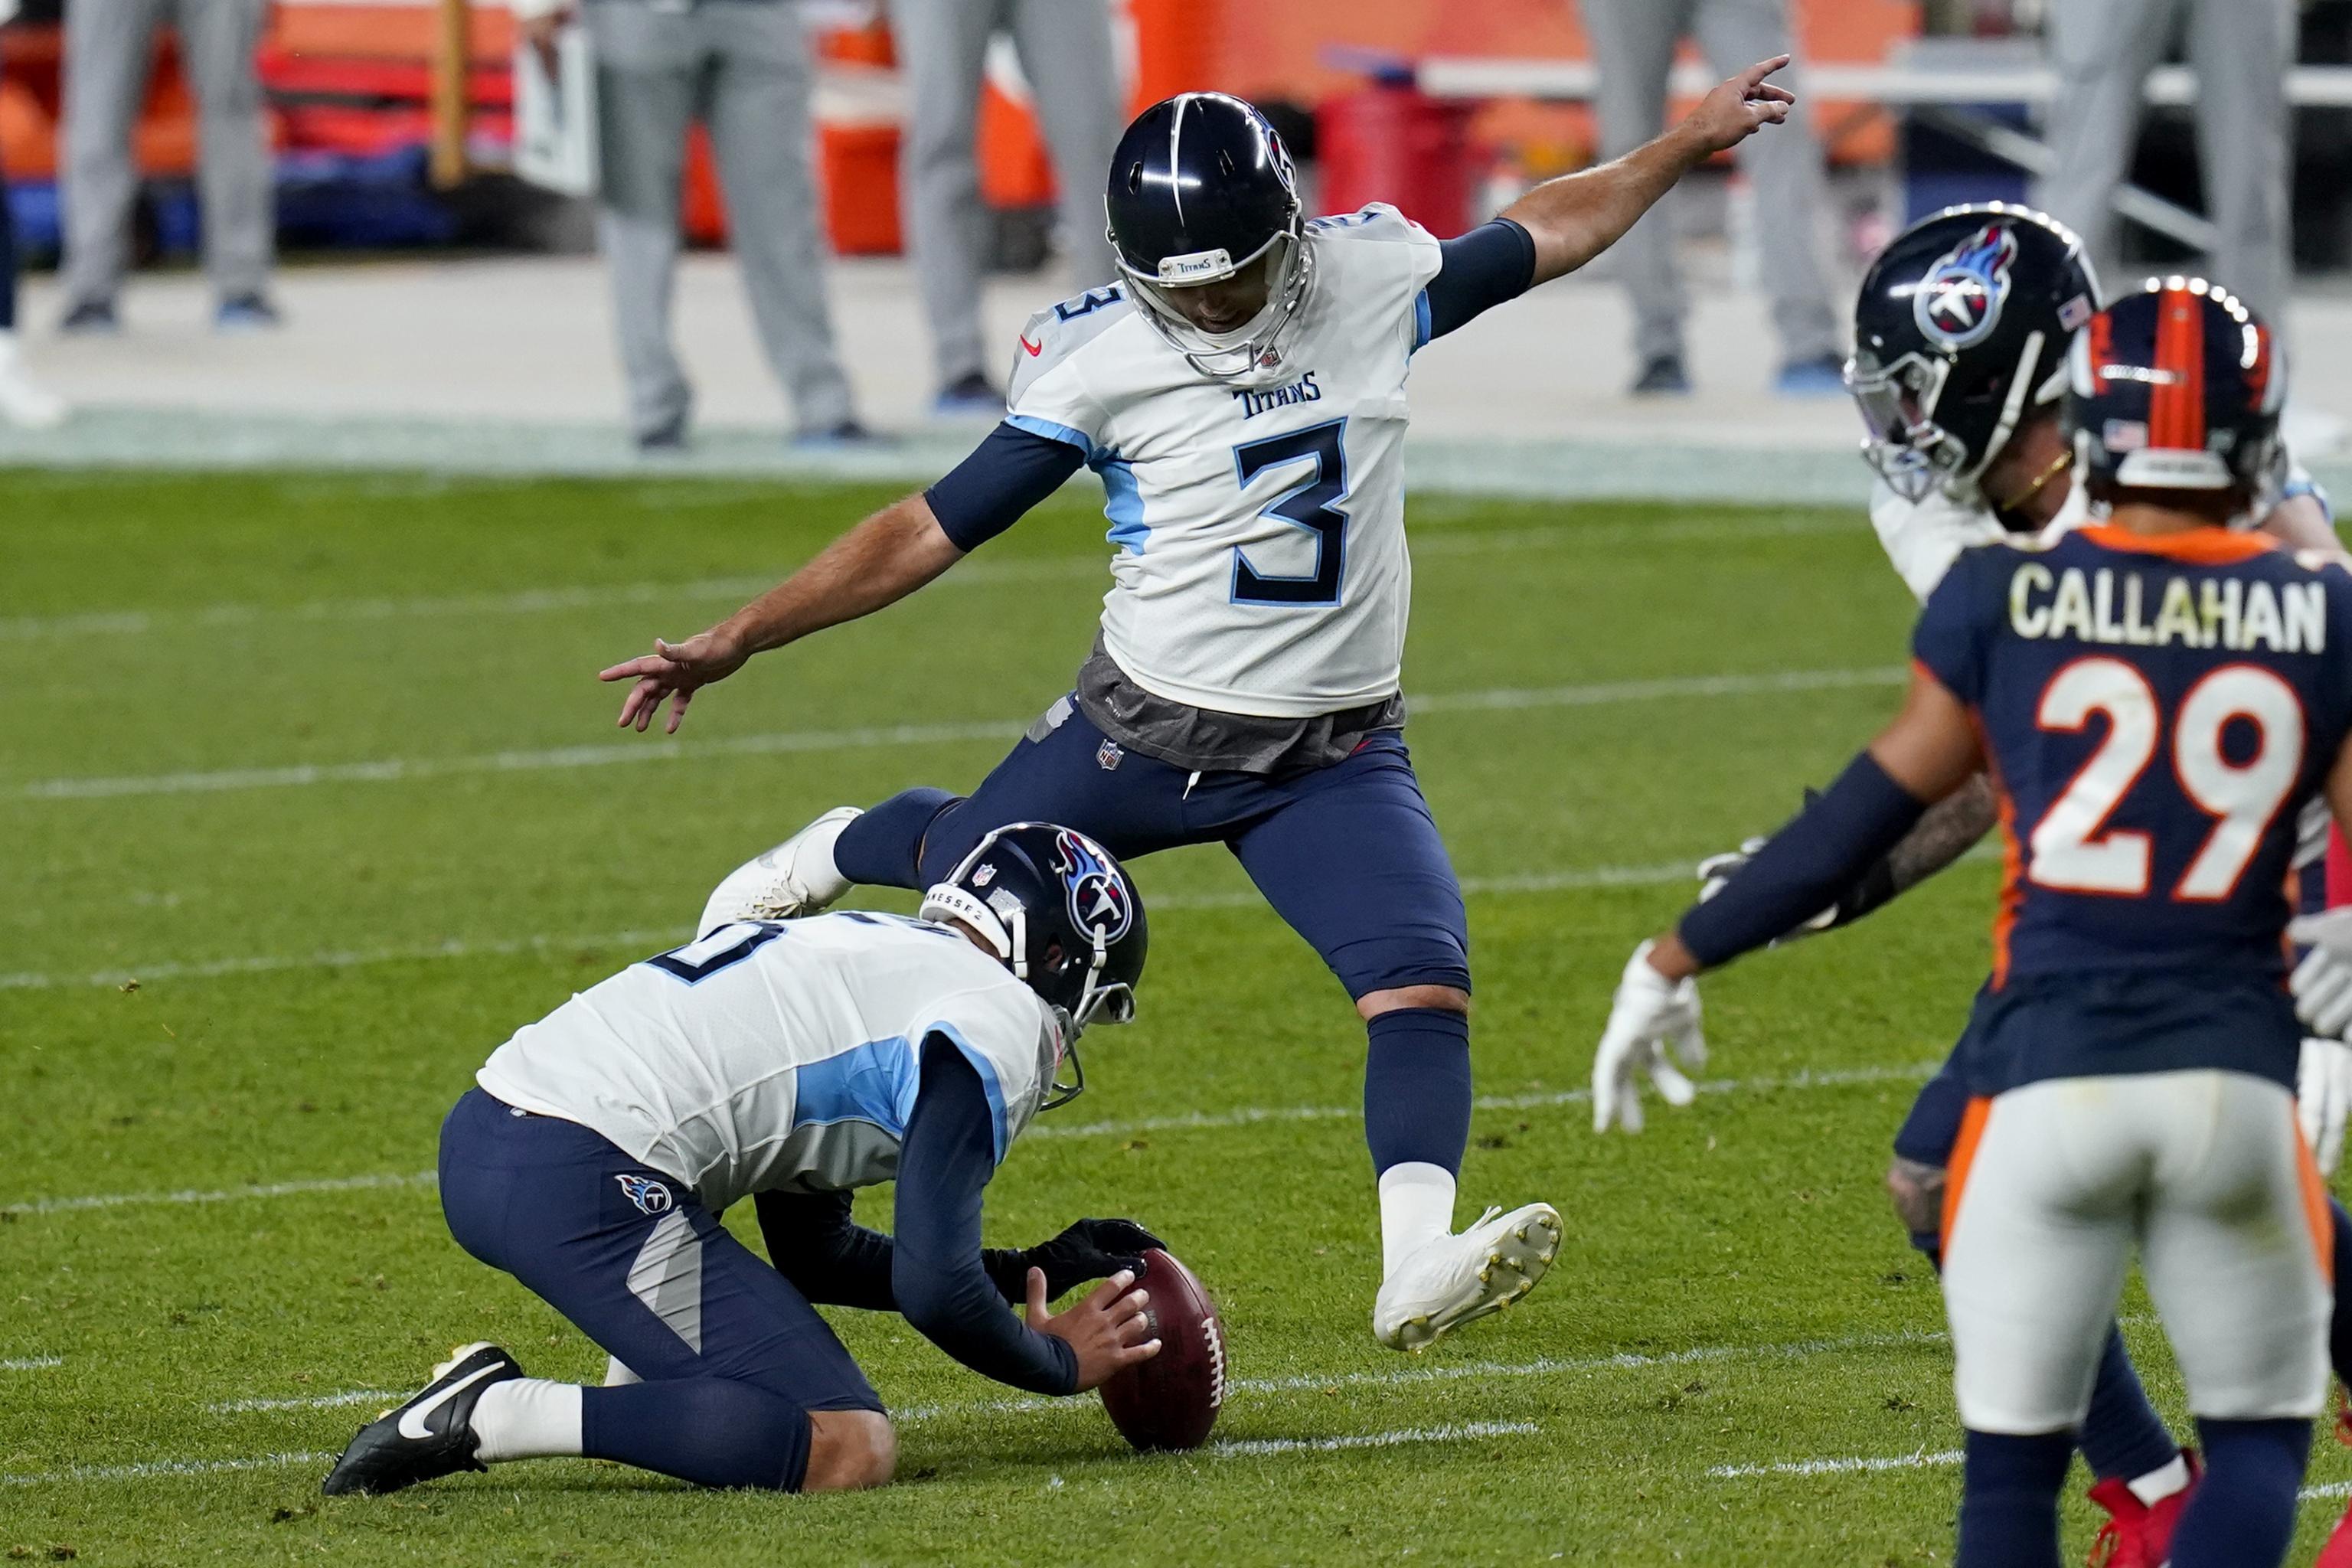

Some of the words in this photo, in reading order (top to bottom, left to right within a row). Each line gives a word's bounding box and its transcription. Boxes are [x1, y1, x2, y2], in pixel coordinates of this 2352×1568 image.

[1232, 370, 1321, 420] TITANS
[1230, 415, 1351, 607] 3
[2009, 562, 2328, 655] CALLAHAN
[2027, 654, 2308, 903] 29
